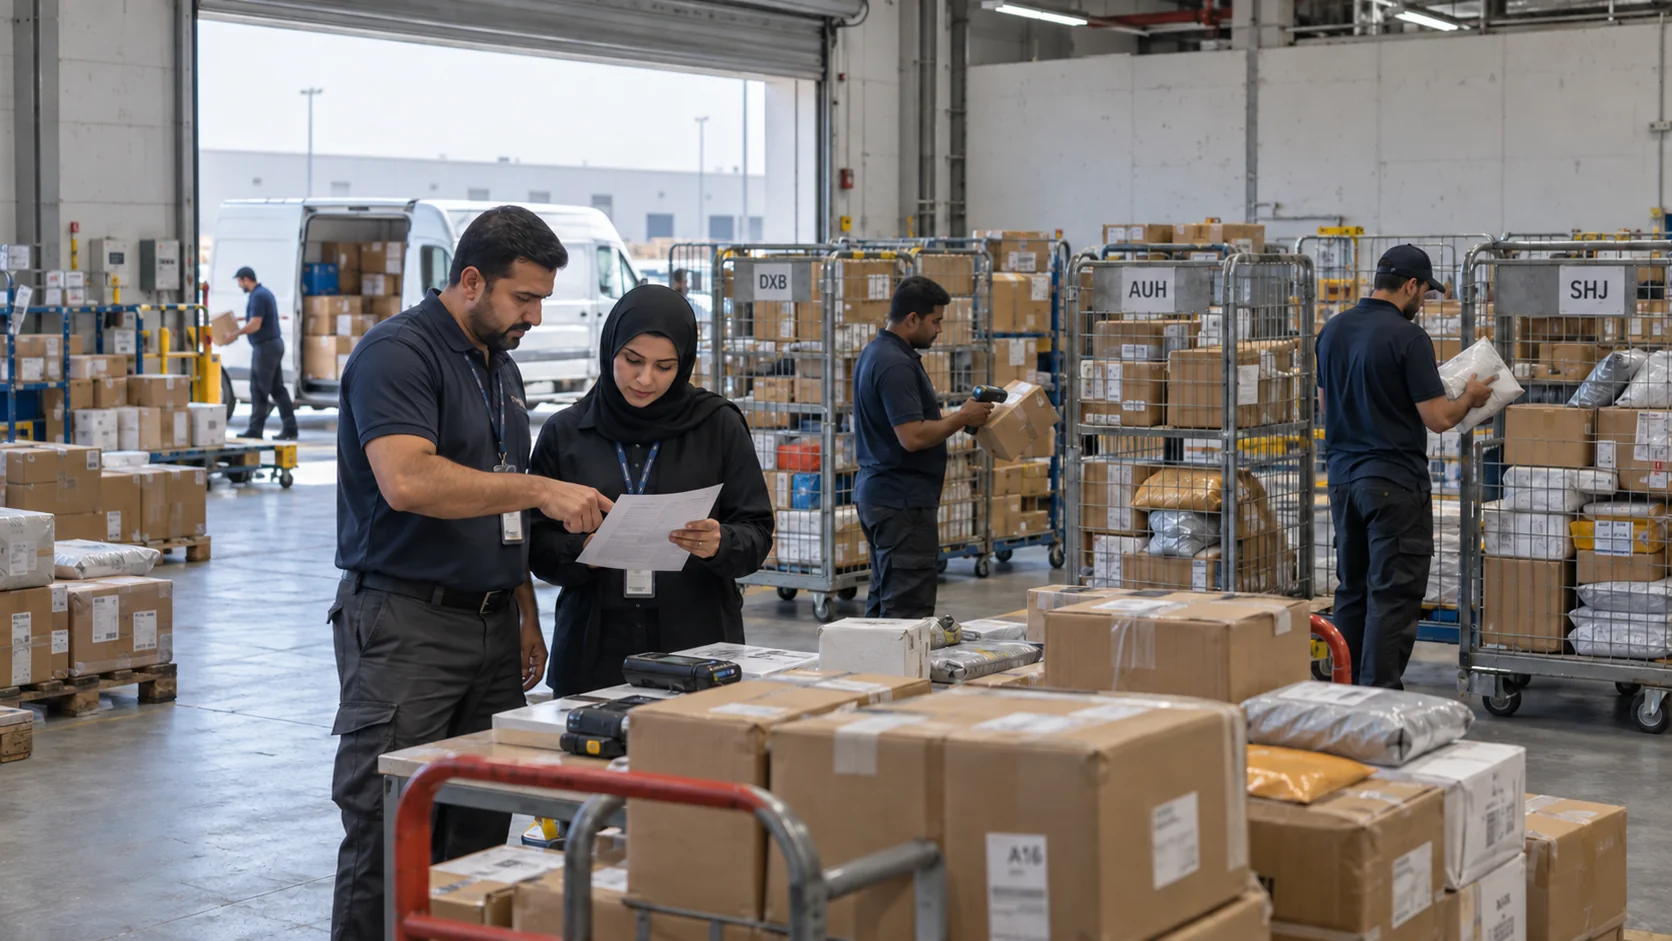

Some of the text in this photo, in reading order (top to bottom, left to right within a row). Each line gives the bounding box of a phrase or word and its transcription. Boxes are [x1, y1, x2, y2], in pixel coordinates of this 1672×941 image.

[759, 274, 787, 290] DXB
[1129, 280, 1167, 298] AUH
[1570, 280, 1608, 299] SHJ
